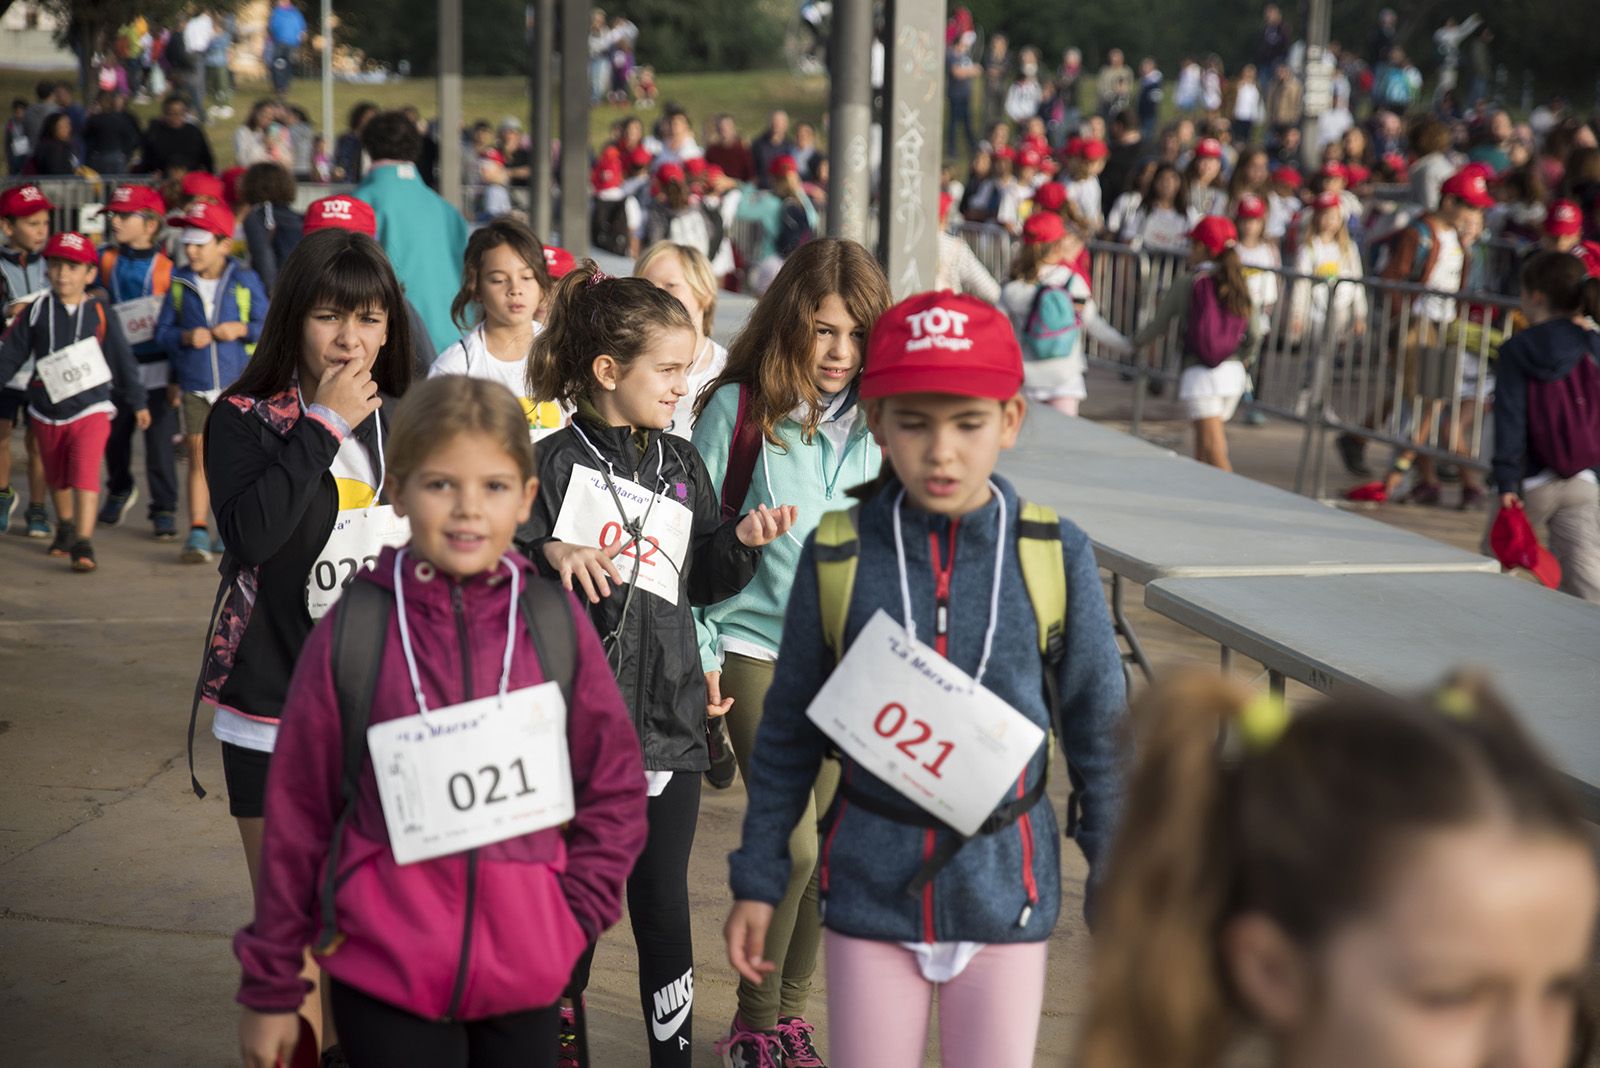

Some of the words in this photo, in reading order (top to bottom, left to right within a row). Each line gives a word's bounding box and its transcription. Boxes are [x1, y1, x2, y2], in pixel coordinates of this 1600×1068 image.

[322, 200, 352, 213] TOT
[905, 306, 969, 337] TOT
[873, 701, 957, 780] 021
[447, 756, 537, 813] 021
[653, 967, 693, 1020] NIKE
